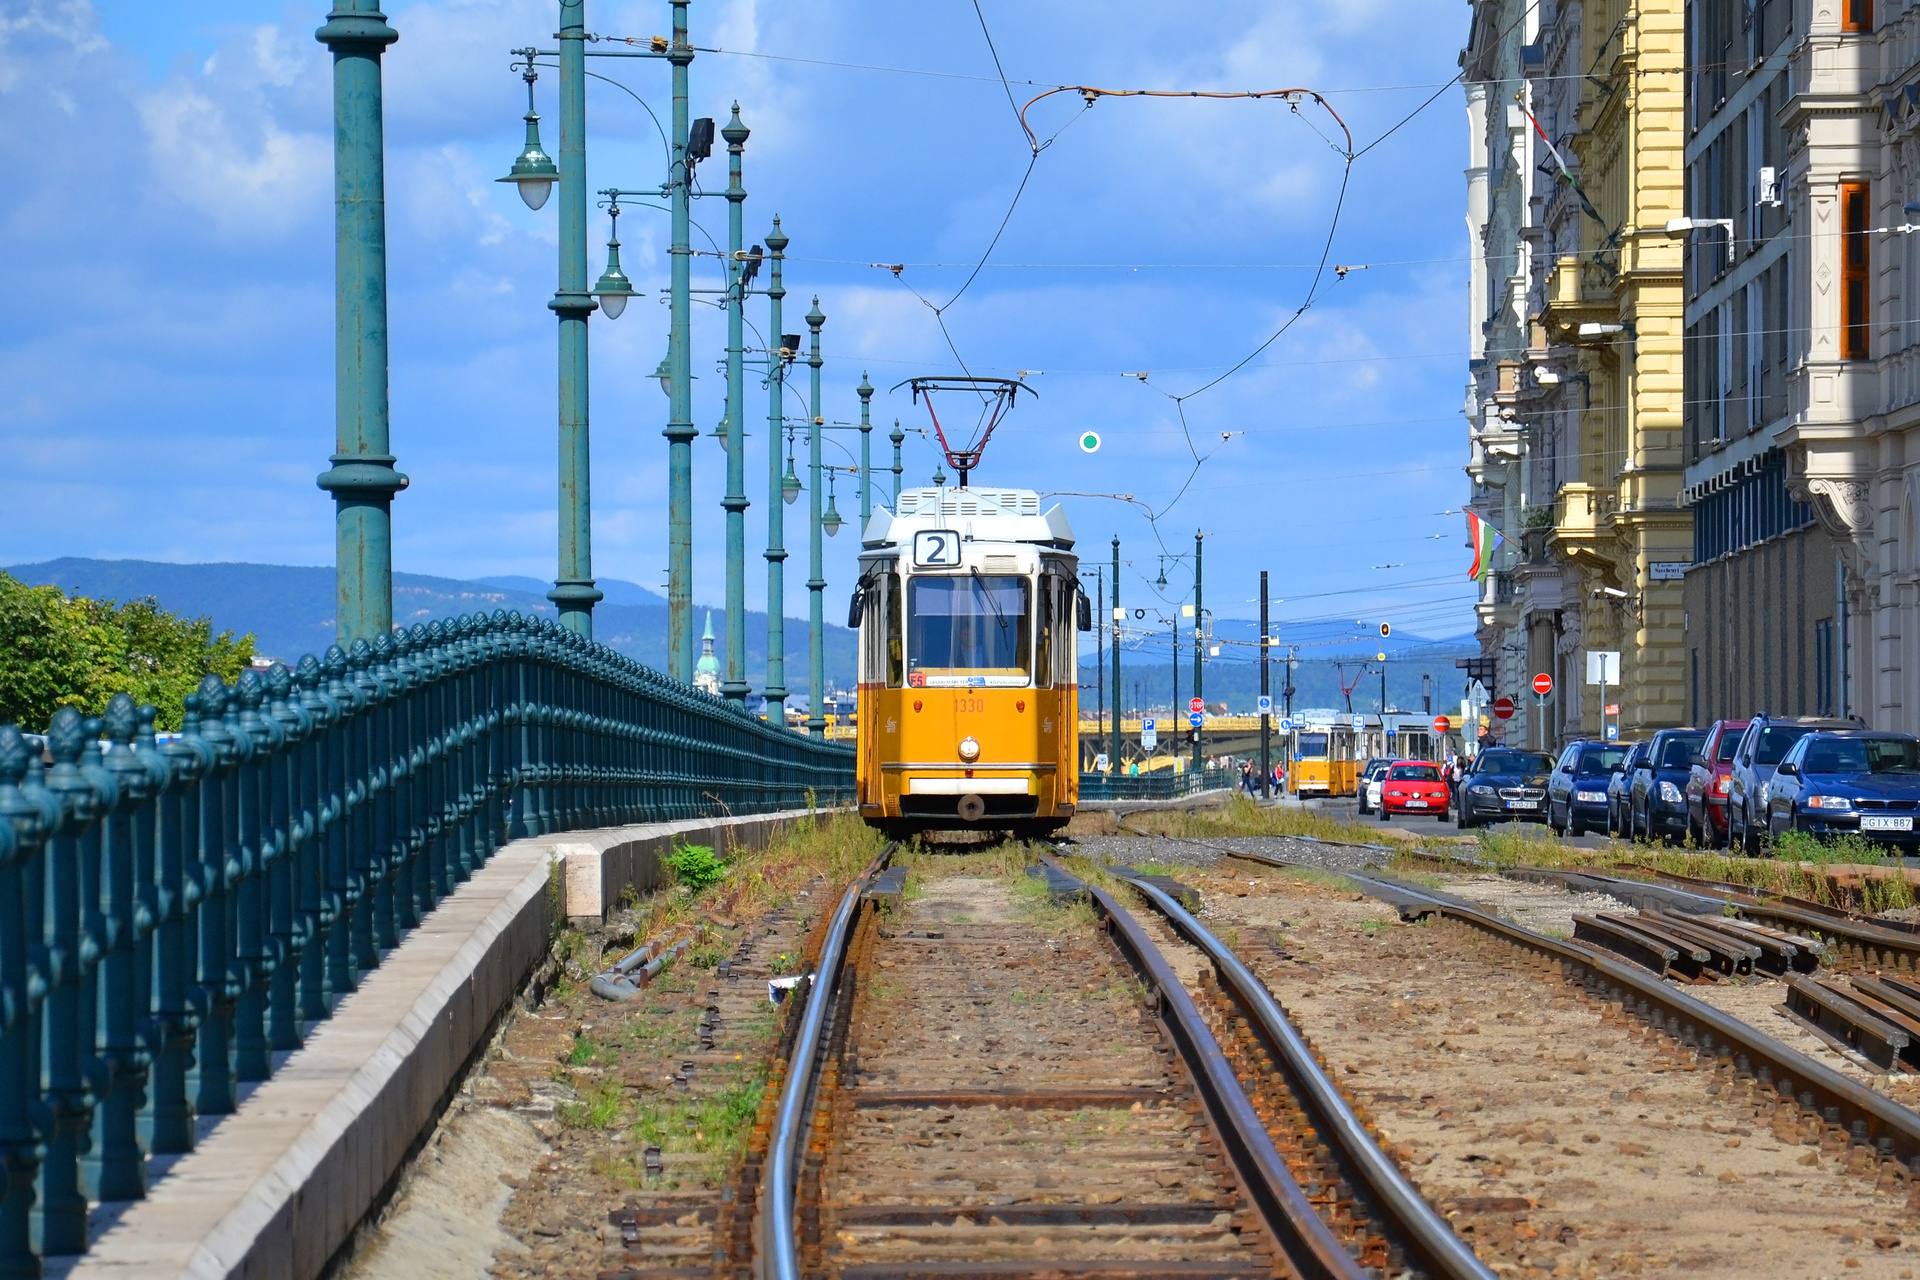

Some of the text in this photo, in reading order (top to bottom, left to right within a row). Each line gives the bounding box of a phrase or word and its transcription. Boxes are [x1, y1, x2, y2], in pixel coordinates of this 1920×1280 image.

[926, 536, 946, 563] 2
[954, 698, 984, 713] 1330
[1190, 701, 1204, 709] STOP
[1145, 720, 1153, 730] P
[1608, 727, 1617, 738] P
[1868, 818, 1911, 828] GIX-887
